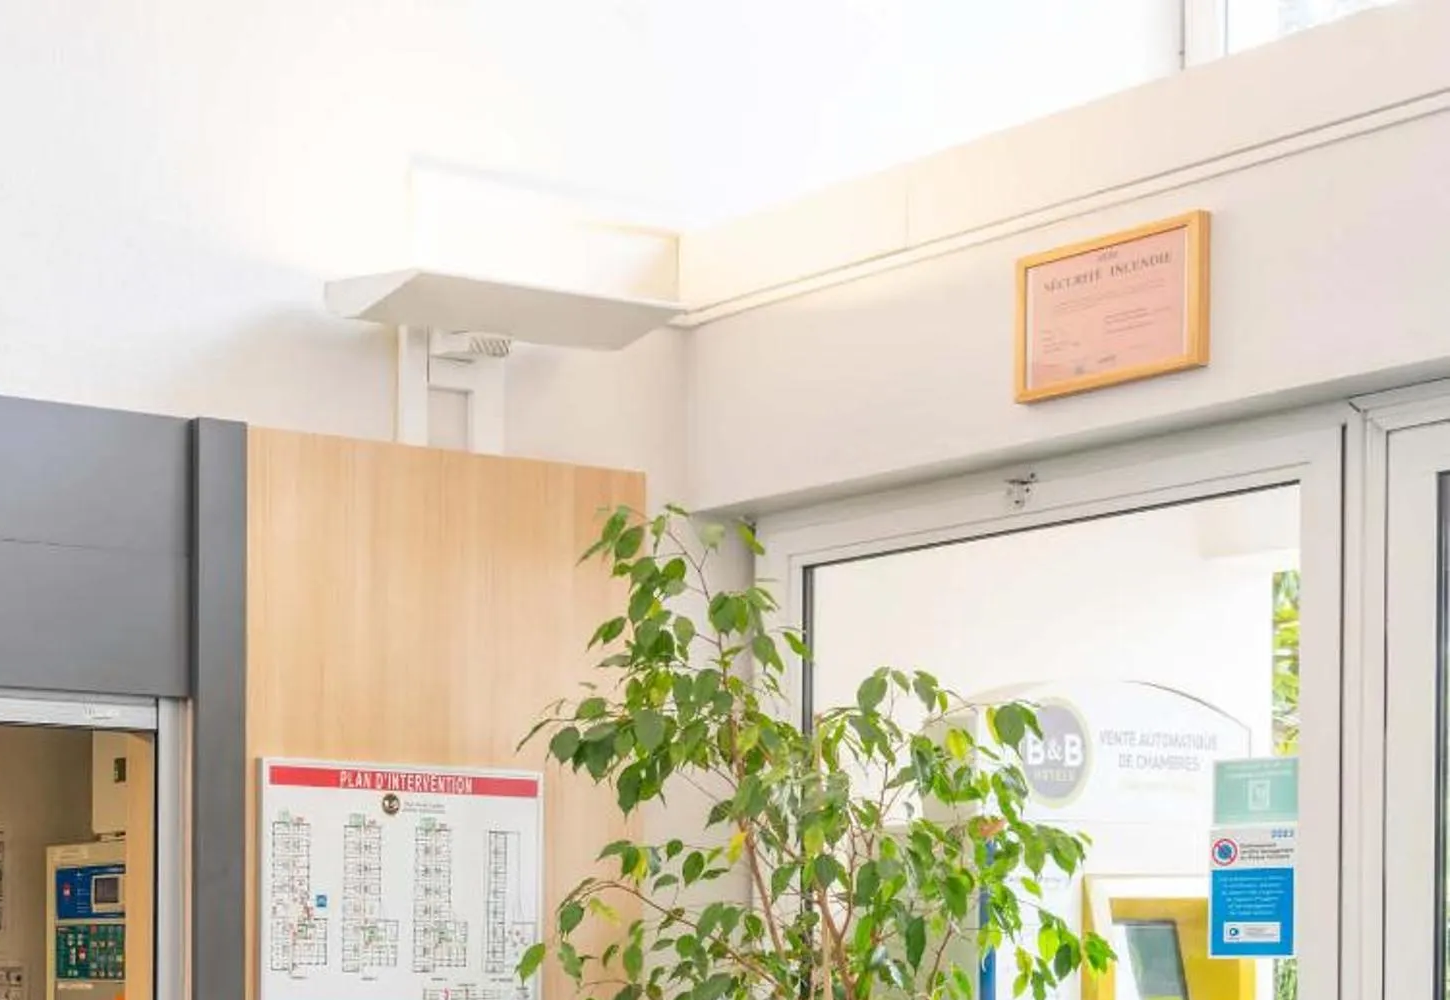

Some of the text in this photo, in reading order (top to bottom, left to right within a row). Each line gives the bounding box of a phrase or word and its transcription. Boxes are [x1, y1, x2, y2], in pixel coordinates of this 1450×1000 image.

[1026, 731, 1084, 767] B&B
[338, 770, 473, 794] PLAN D'INTERVENTION
